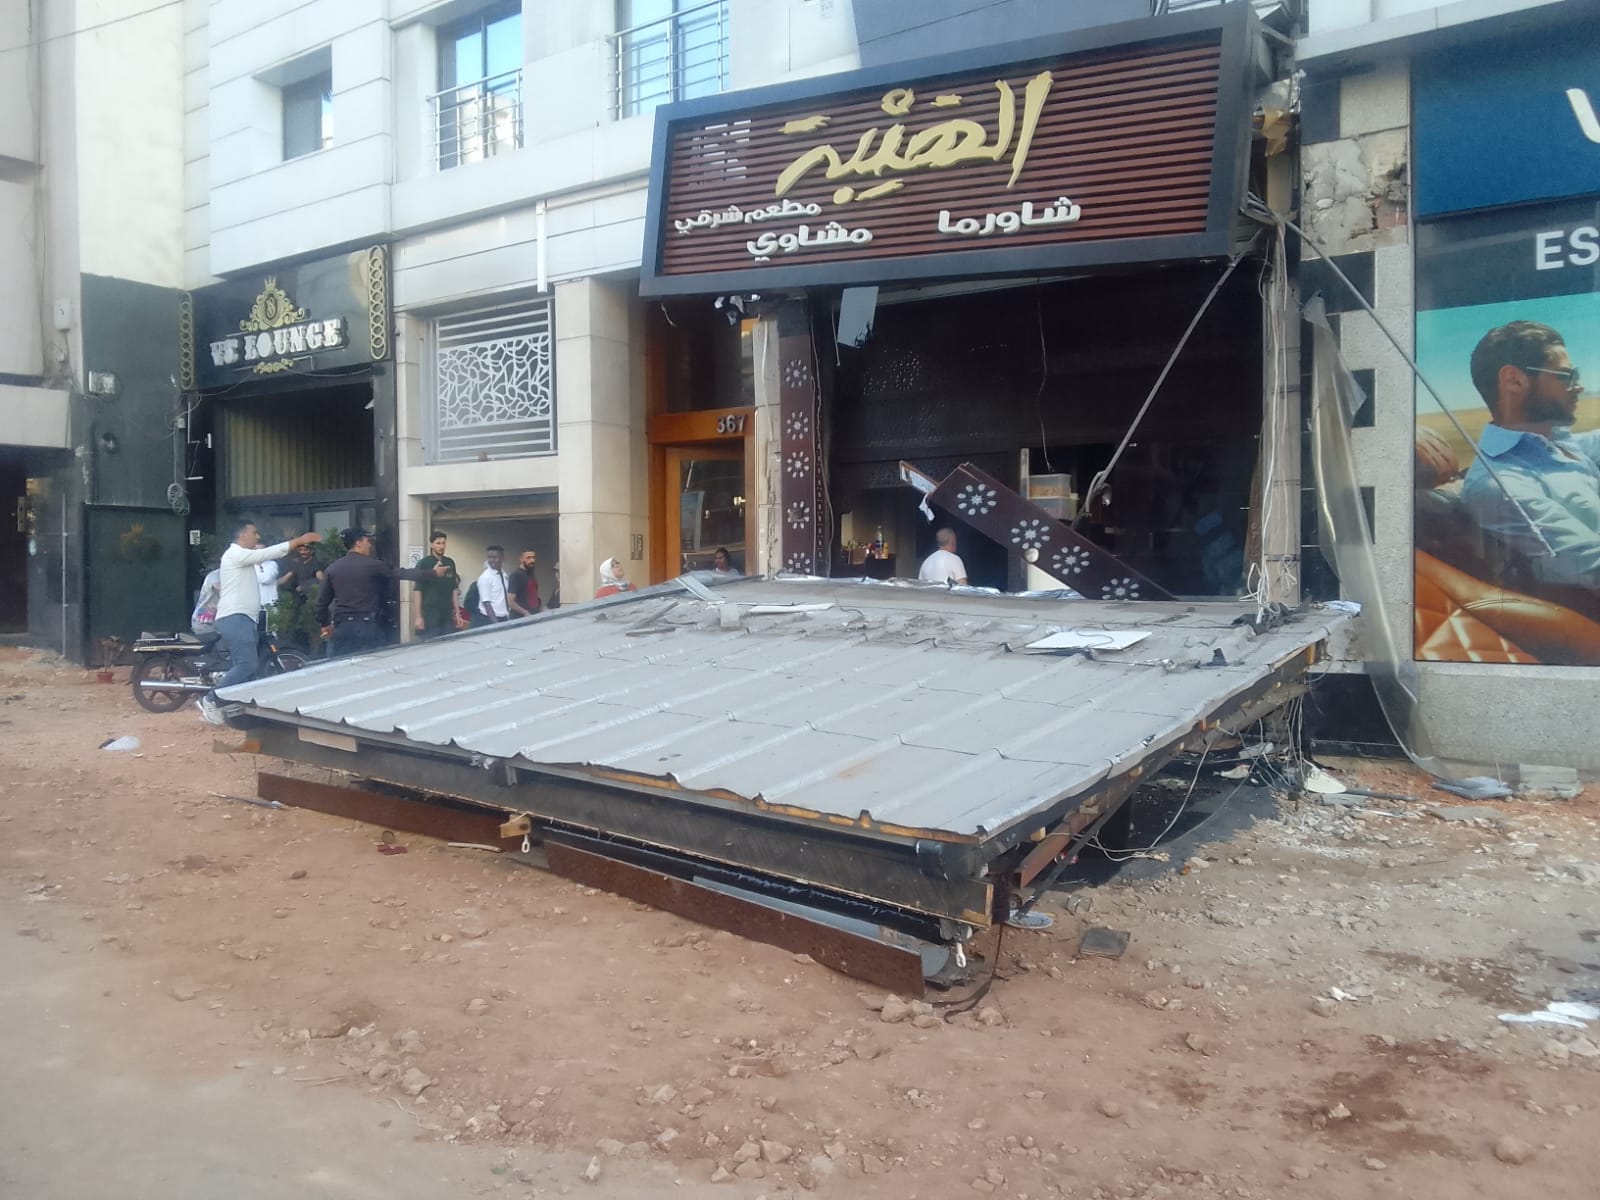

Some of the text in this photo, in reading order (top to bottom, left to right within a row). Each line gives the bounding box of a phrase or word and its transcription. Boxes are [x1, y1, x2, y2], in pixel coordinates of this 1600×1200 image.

[674, 198, 822, 235] مطعم شرقي
[938, 196, 1081, 235] شاورما
[747, 221, 873, 262] مشاوي
[244, 318, 342, 360] LOUNGE
[716, 414, 746, 433] 367
